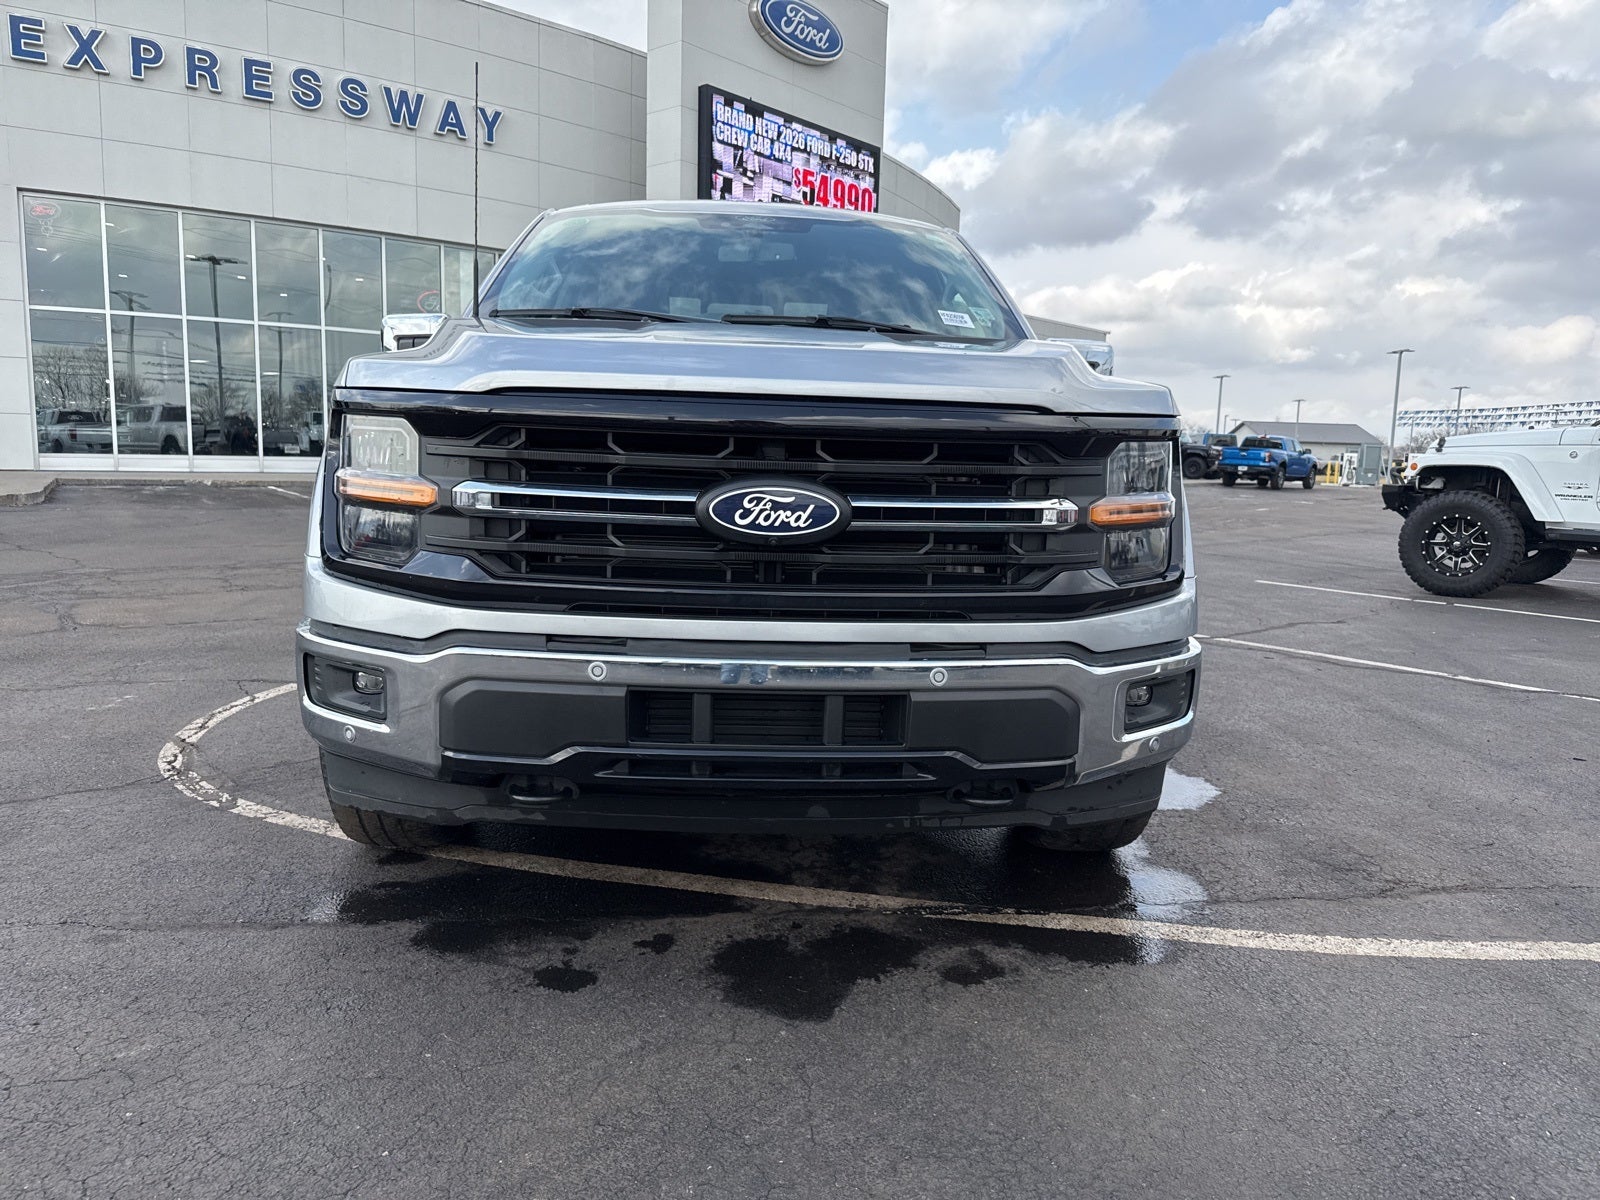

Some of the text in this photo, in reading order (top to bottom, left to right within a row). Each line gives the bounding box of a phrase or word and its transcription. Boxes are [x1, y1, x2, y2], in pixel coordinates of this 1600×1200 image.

[780, 4, 830, 49] Ford
[8, 13, 503, 145] EXPRESSWAY
[716, 102, 874, 173] BRAND NEW 2026 FORD F-250 STX
[716, 121, 748, 148] CREW
[750, 134, 771, 157] CAB
[734, 493, 815, 527] Ford
